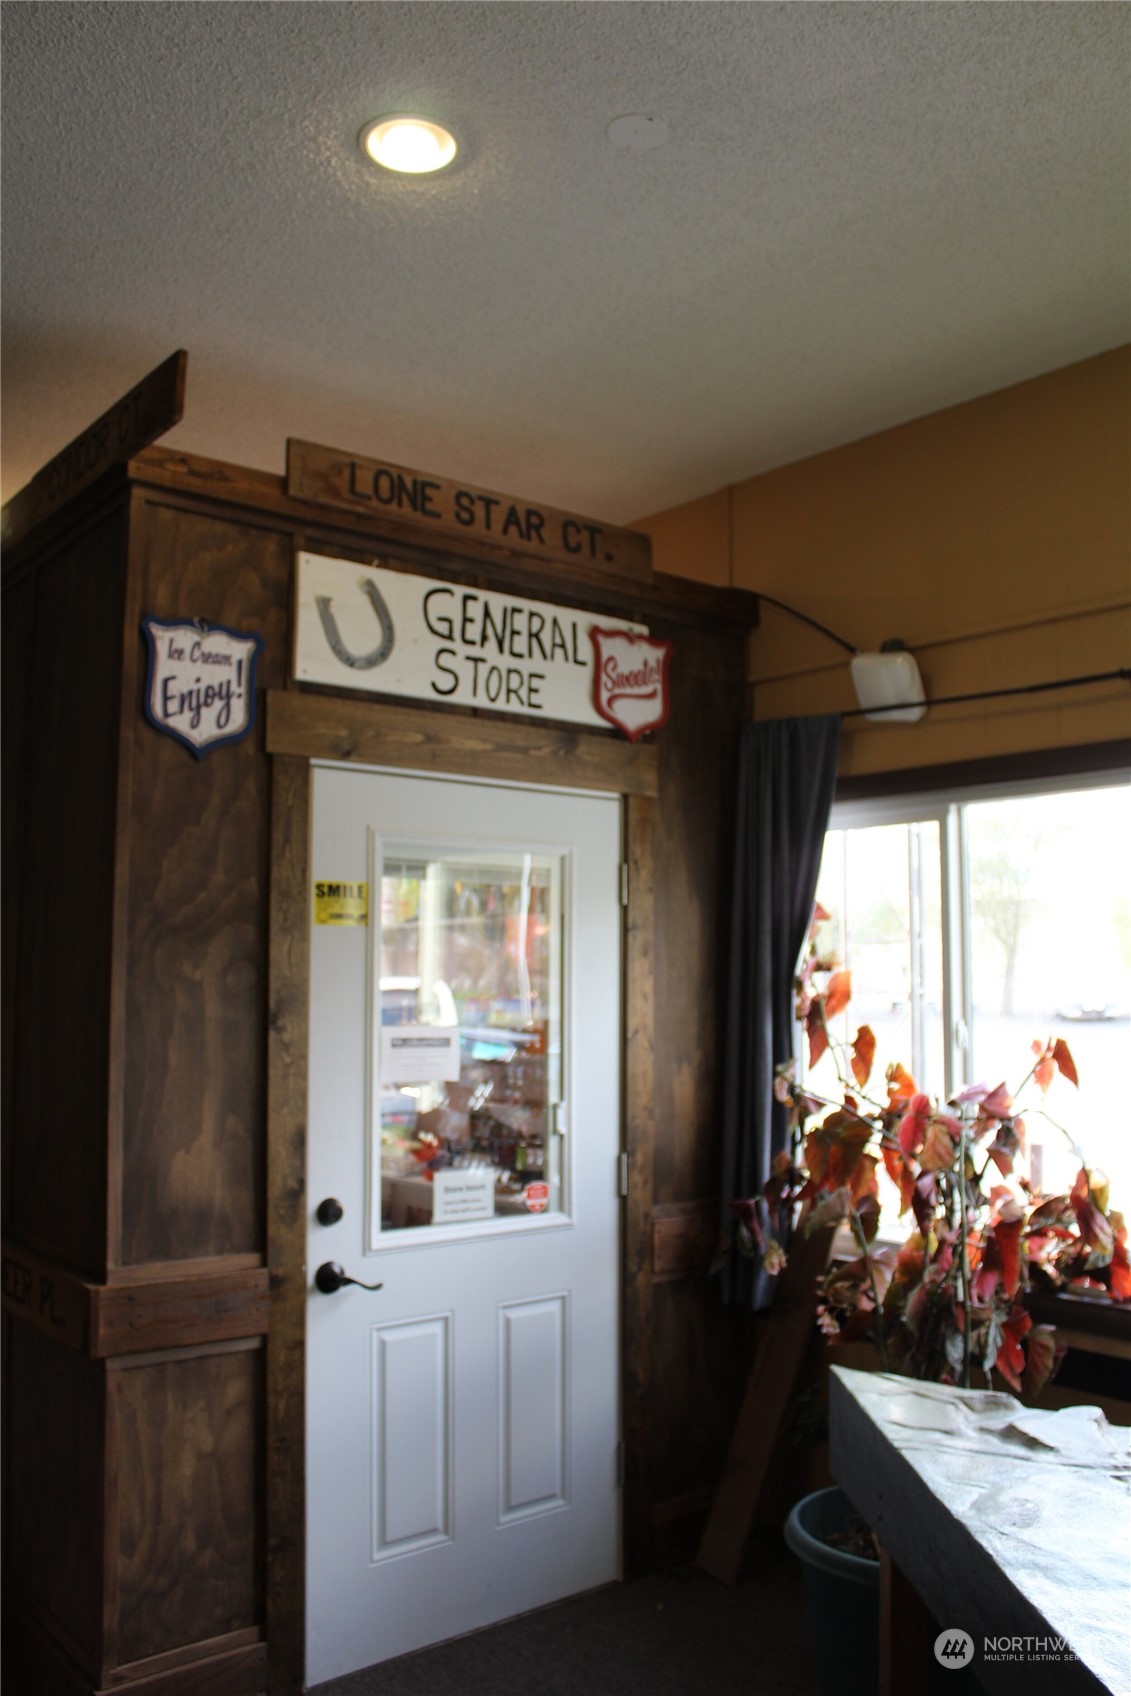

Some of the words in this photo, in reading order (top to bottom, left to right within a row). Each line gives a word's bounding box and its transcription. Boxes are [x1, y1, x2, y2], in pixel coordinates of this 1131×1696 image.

[349, 461, 441, 518] LONE
[454, 490, 545, 543] STAR
[562, 520, 615, 562] CT.
[166, 638, 186, 663] Ice
[190, 641, 233, 667] Cream
[423, 587, 589, 667] GENERAL
[162, 659, 244, 730] Enjoy!
[431, 647, 546, 709] STORE
[604, 655, 661, 692] Sweets!
[316, 883, 365, 900] SMILE
